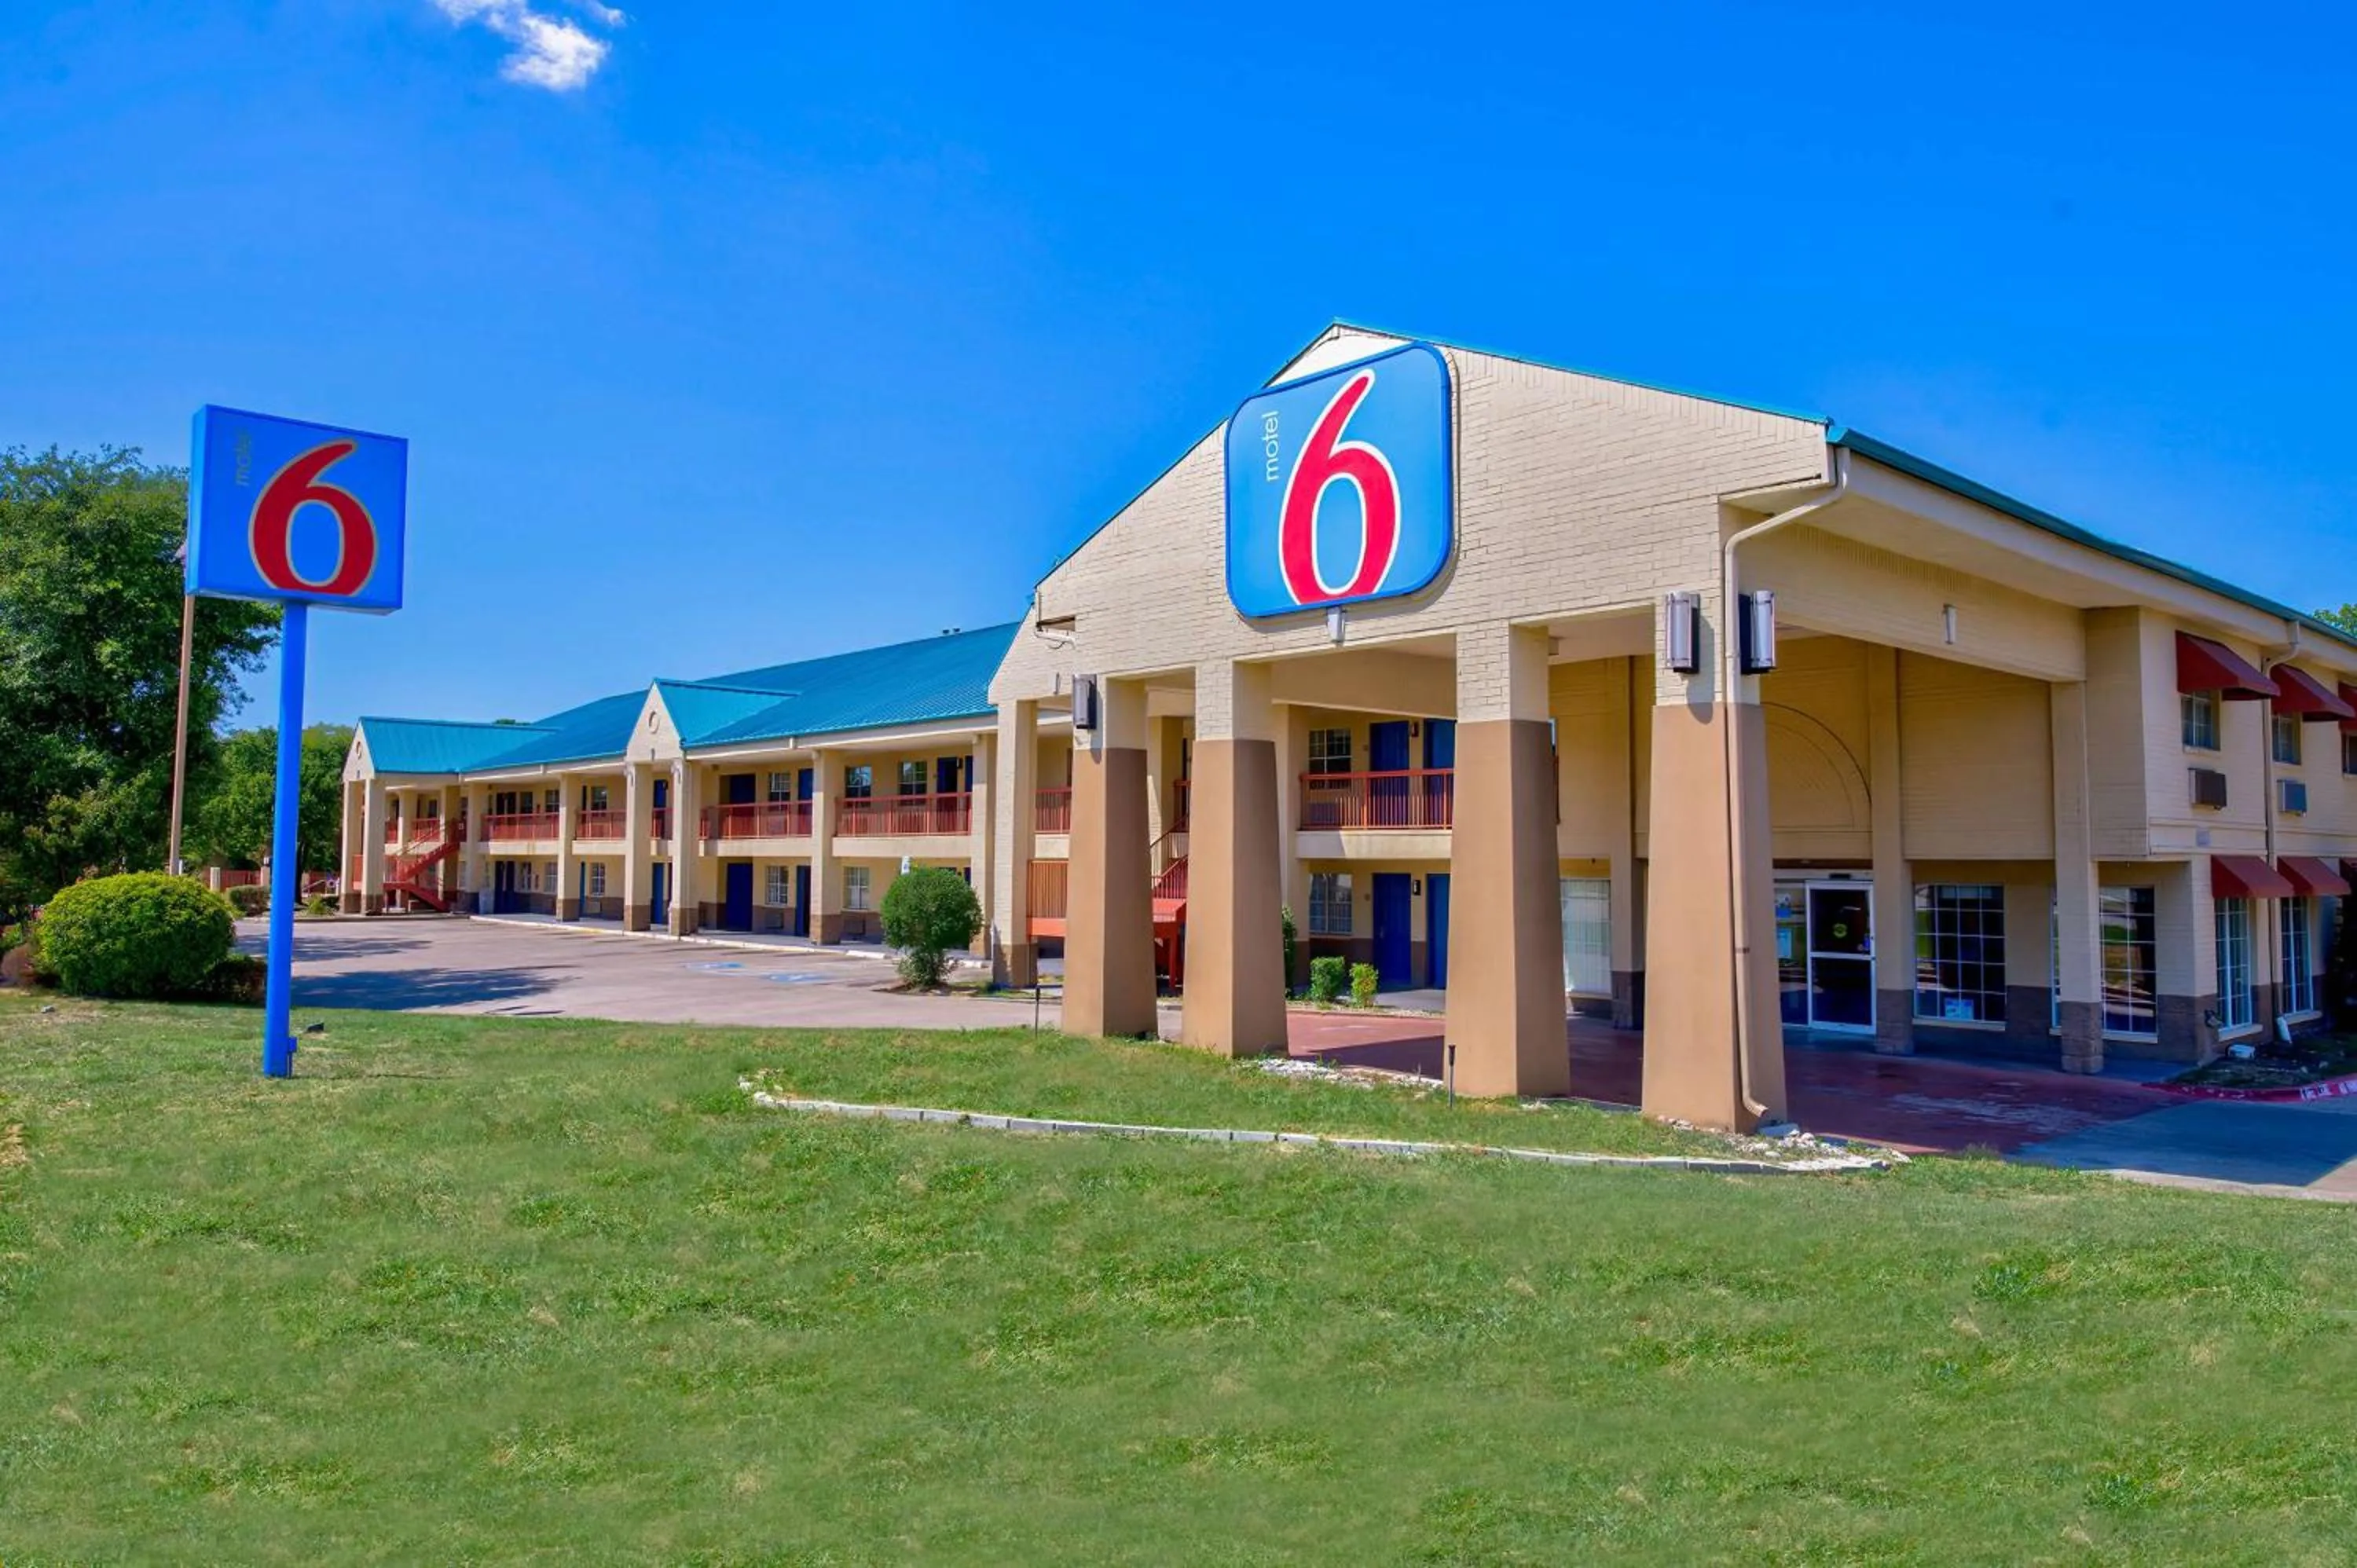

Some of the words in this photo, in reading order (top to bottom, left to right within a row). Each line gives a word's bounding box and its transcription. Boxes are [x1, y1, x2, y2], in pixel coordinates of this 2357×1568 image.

[234, 428, 251, 486] mot
[1262, 411, 1279, 482] motel
[1278, 368, 1402, 605] 6
[248, 436, 379, 597] 6
